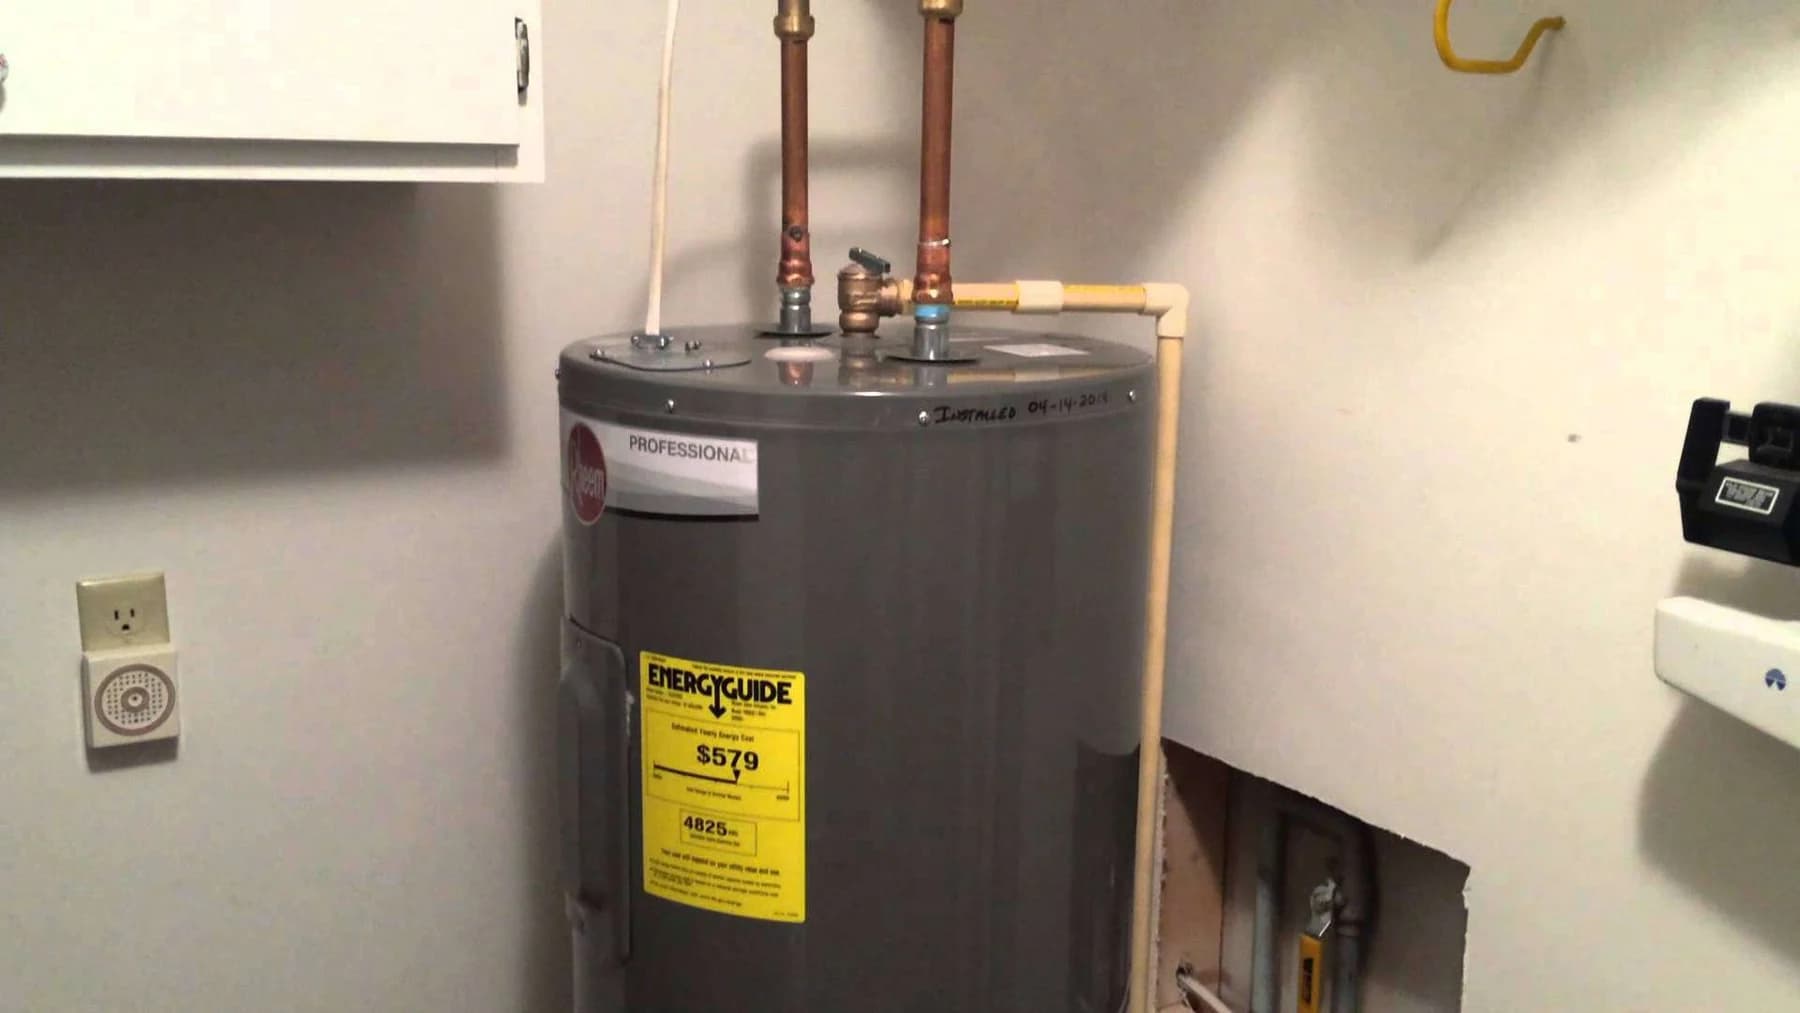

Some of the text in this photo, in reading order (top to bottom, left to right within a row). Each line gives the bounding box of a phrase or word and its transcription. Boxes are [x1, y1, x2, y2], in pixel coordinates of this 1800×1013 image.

[934, 405, 1016, 424] INSTALLED
[629, 434, 755, 464] PROFESSIONAL
[648, 663, 792, 705] ENERGYGUIDE
[697, 744, 759, 771] $579
[684, 815, 728, 837] 4825
